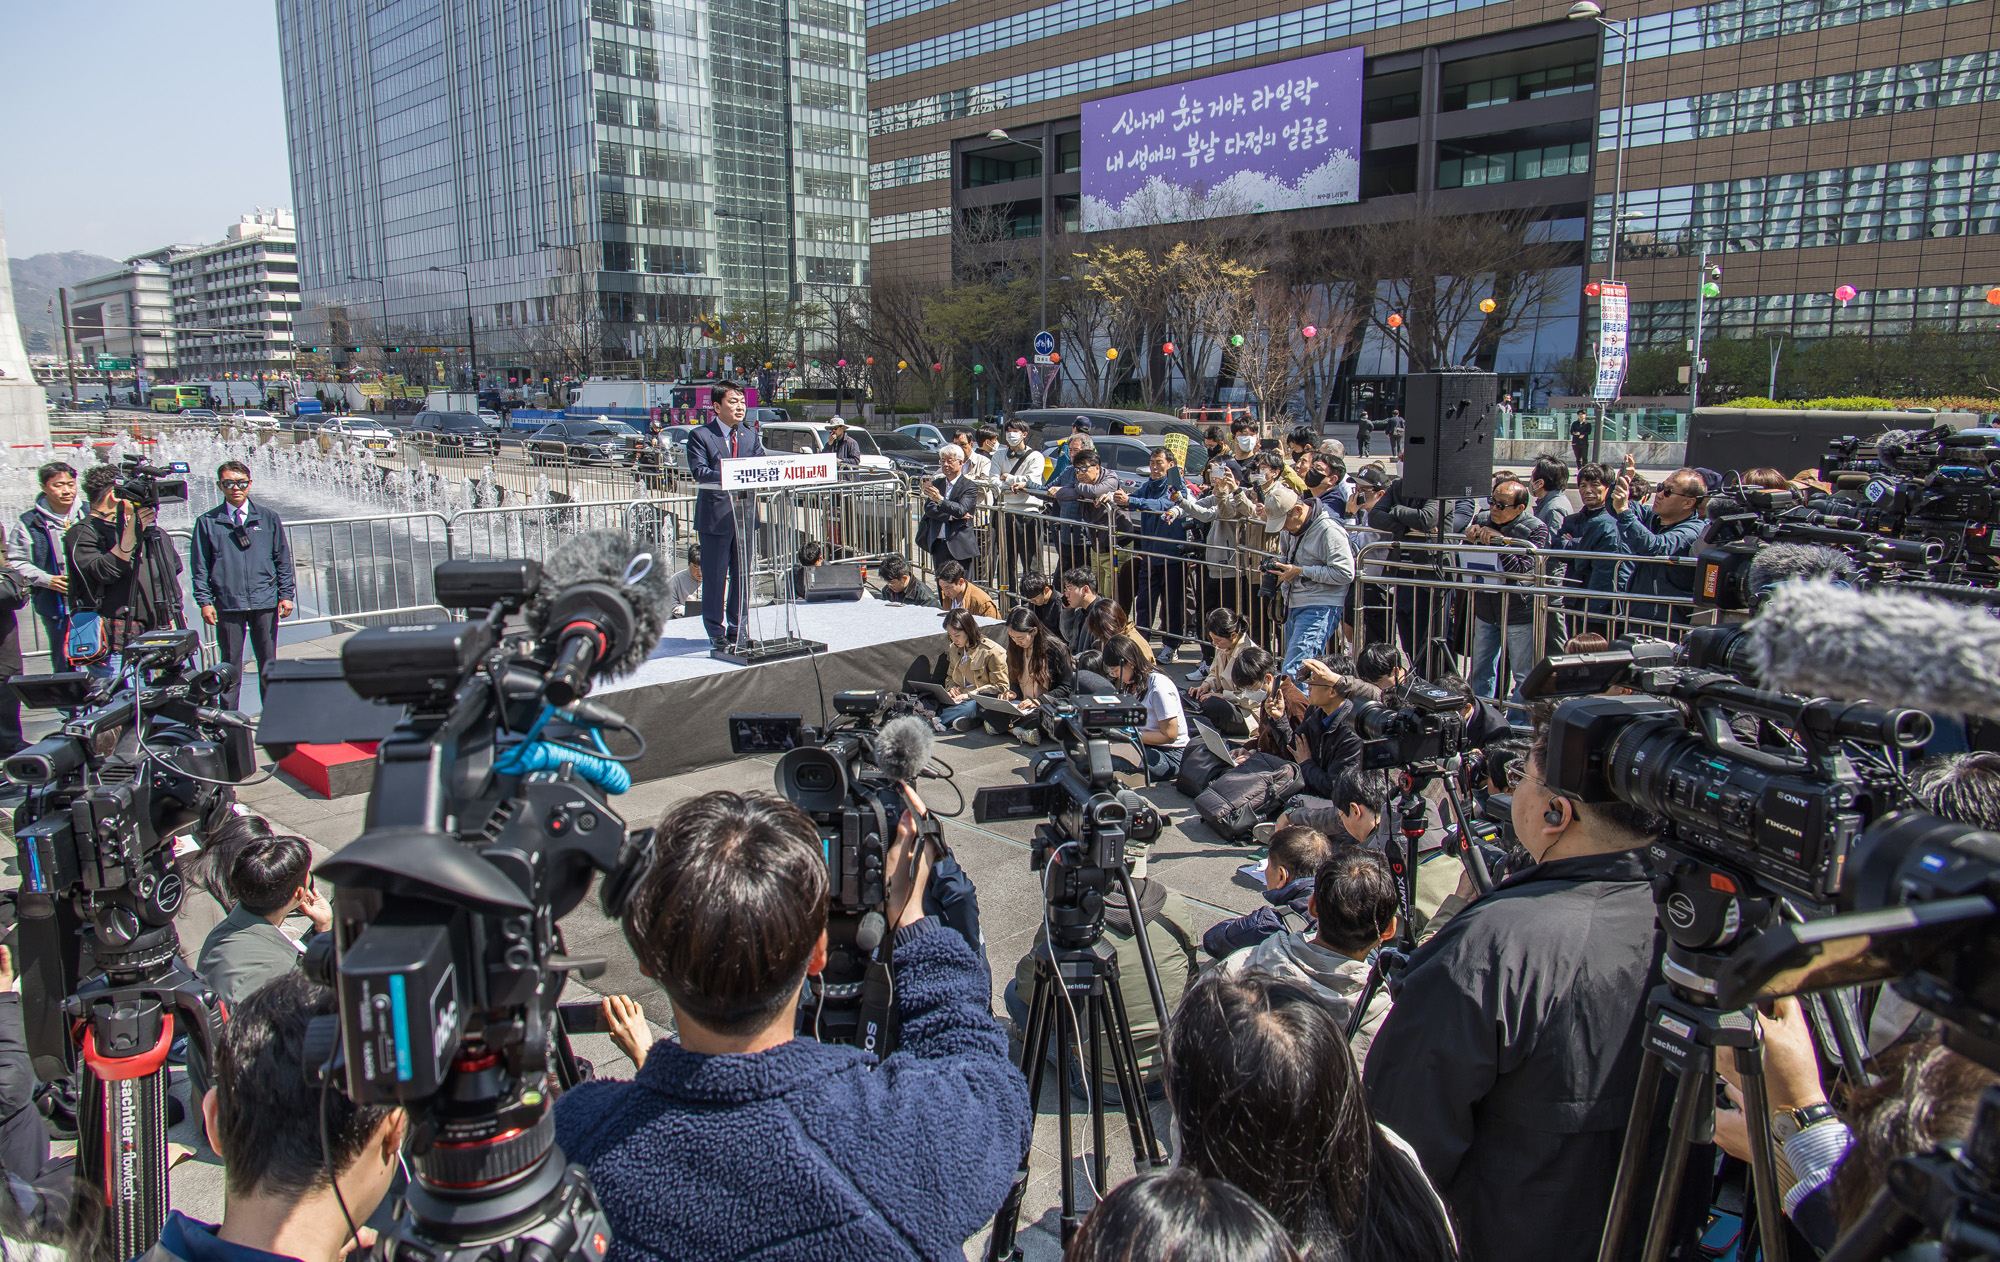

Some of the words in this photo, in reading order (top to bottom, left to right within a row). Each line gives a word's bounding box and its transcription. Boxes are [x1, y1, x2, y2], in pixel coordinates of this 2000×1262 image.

[1112, 109, 1164, 135] 신나게
[1252, 77, 1318, 112] 라일락
[1107, 151, 1123, 172] 내
[1127, 145, 1176, 171] 생애의
[1182, 130, 1220, 168] 봄날
[1224, 125, 1276, 155] 다정의
[1282, 117, 1329, 151] 얼굴로
[733, 467, 780, 484] 국민통합
[783, 464, 827, 480] 시대교체
[1777, 791, 1809, 807] SONY
[1392, 863, 1403, 874] G
[1650, 846, 1667, 859] ace
[1396, 875, 1409, 921] LUMIX
[1652, 1037, 1687, 1058] sachtler
[121, 1079, 137, 1143] sachtler
[122, 1151, 138, 1201] flowtech
